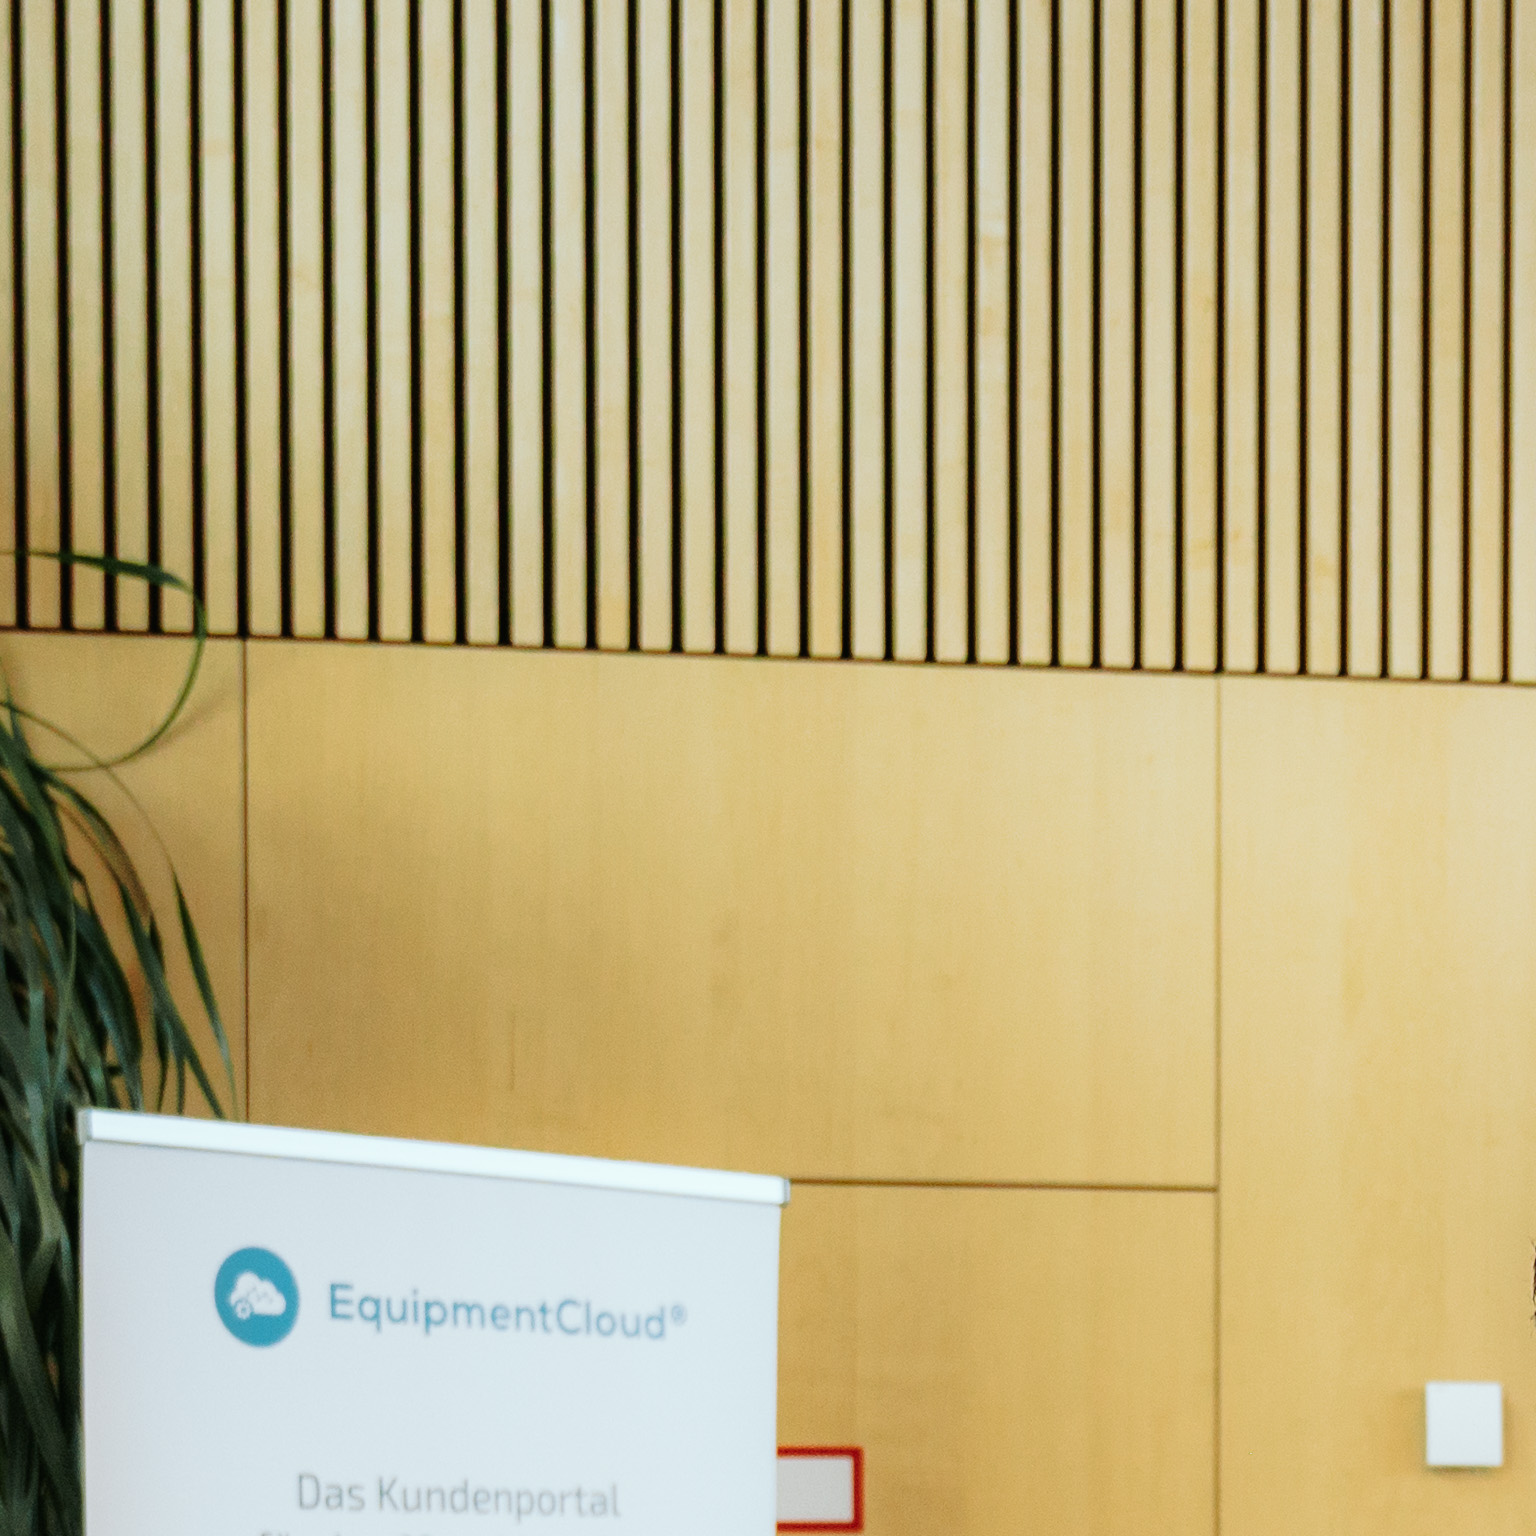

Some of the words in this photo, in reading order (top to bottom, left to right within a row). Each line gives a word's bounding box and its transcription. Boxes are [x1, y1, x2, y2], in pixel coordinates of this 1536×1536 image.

[328, 1282, 688, 1341] EquipmentCloud®
[296, 1472, 367, 1512] Das
[378, 1476, 622, 1522] Kundenportal
